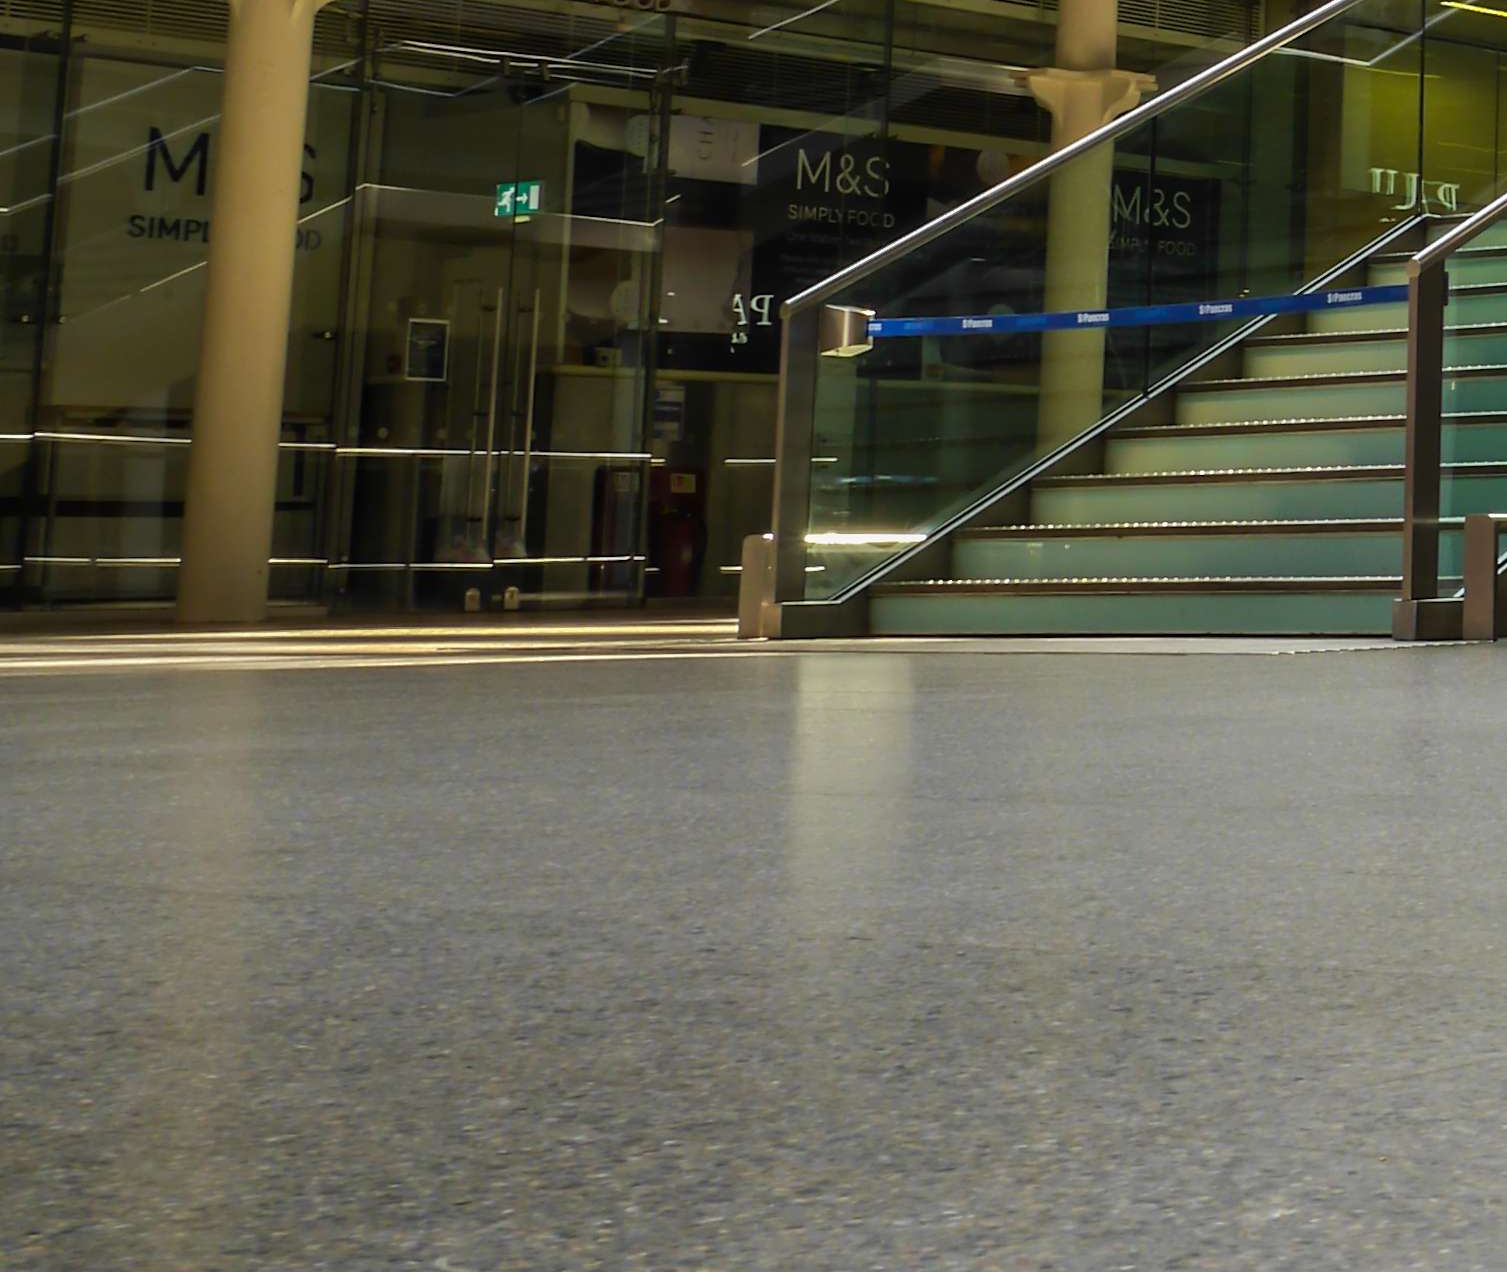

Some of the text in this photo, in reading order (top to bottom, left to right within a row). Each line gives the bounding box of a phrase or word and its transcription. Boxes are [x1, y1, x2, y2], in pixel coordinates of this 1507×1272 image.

[795, 148, 891, 199] M&S
[787, 203, 896, 229] SIMPLY FOOD
[1113, 184, 1192, 229] M&S
[127, 214, 209, 243] SIMPL
